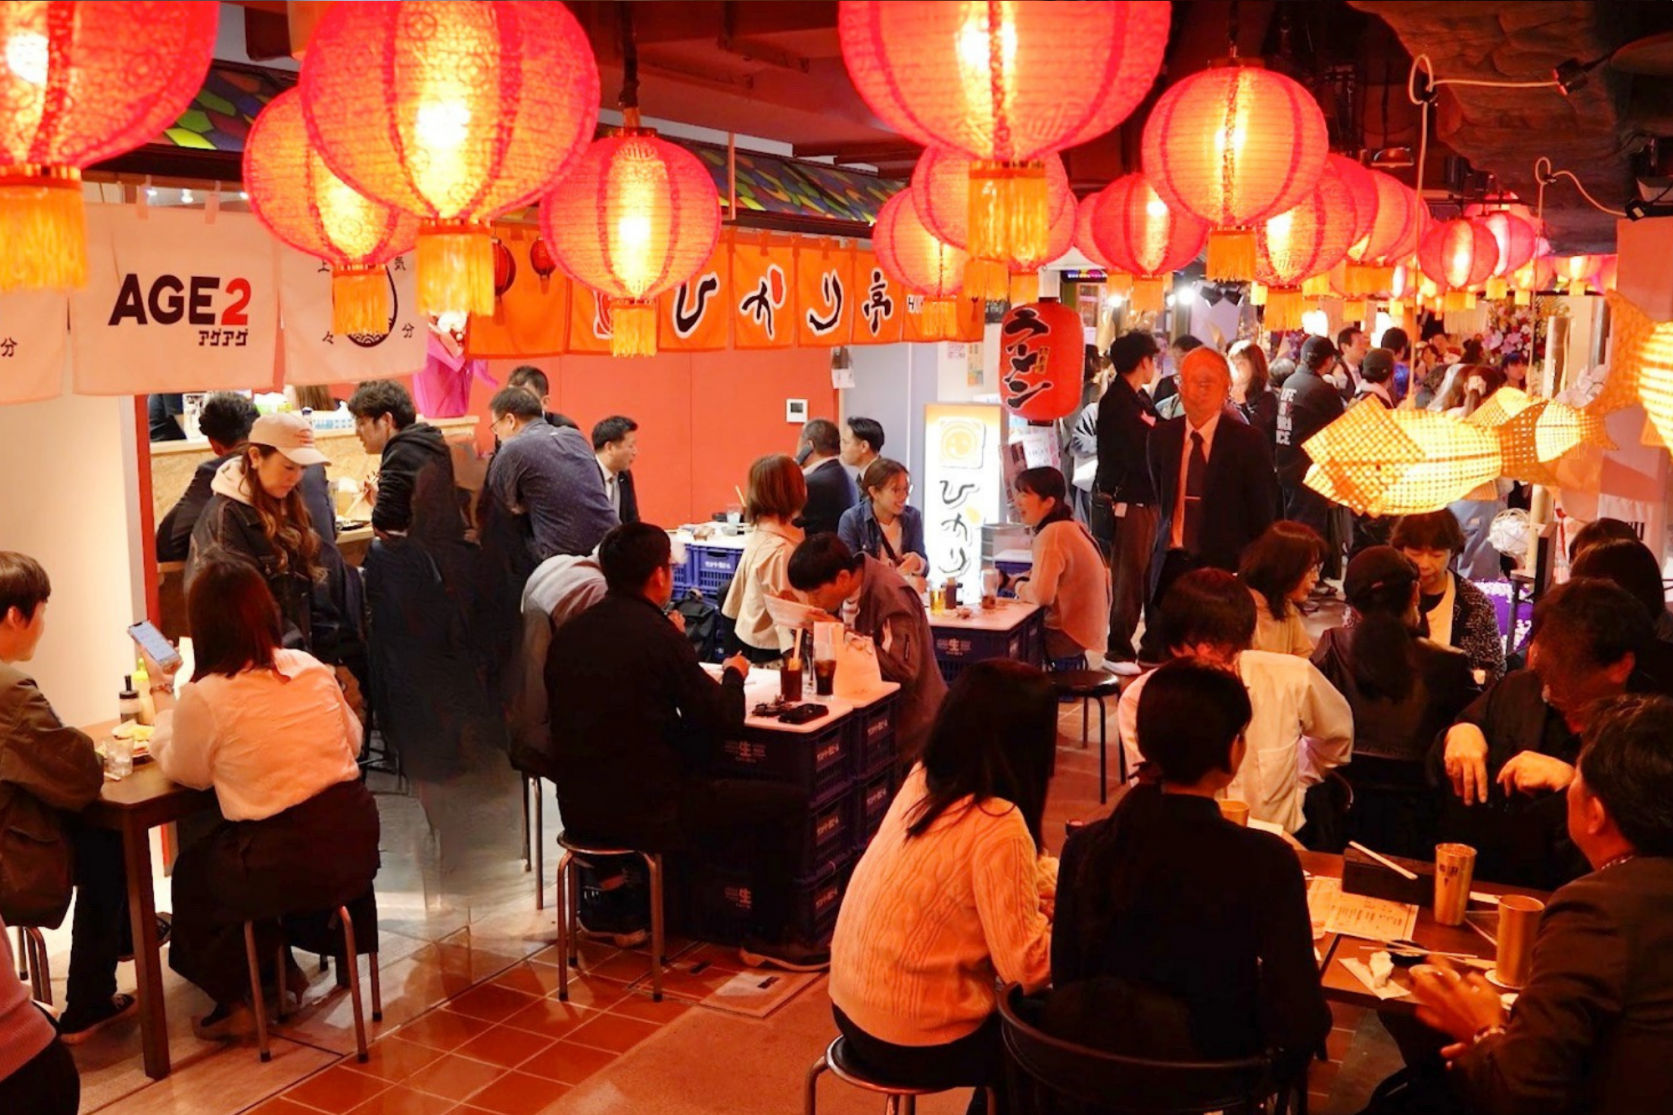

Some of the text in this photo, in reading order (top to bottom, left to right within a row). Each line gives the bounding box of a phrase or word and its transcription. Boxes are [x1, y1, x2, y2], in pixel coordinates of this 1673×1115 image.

[108, 273, 252, 326] AGE2
[673, 265, 894, 340] ひかり亭
[198, 328, 249, 347] アゲアゲ
[938, 479, 980, 576] ひかり
